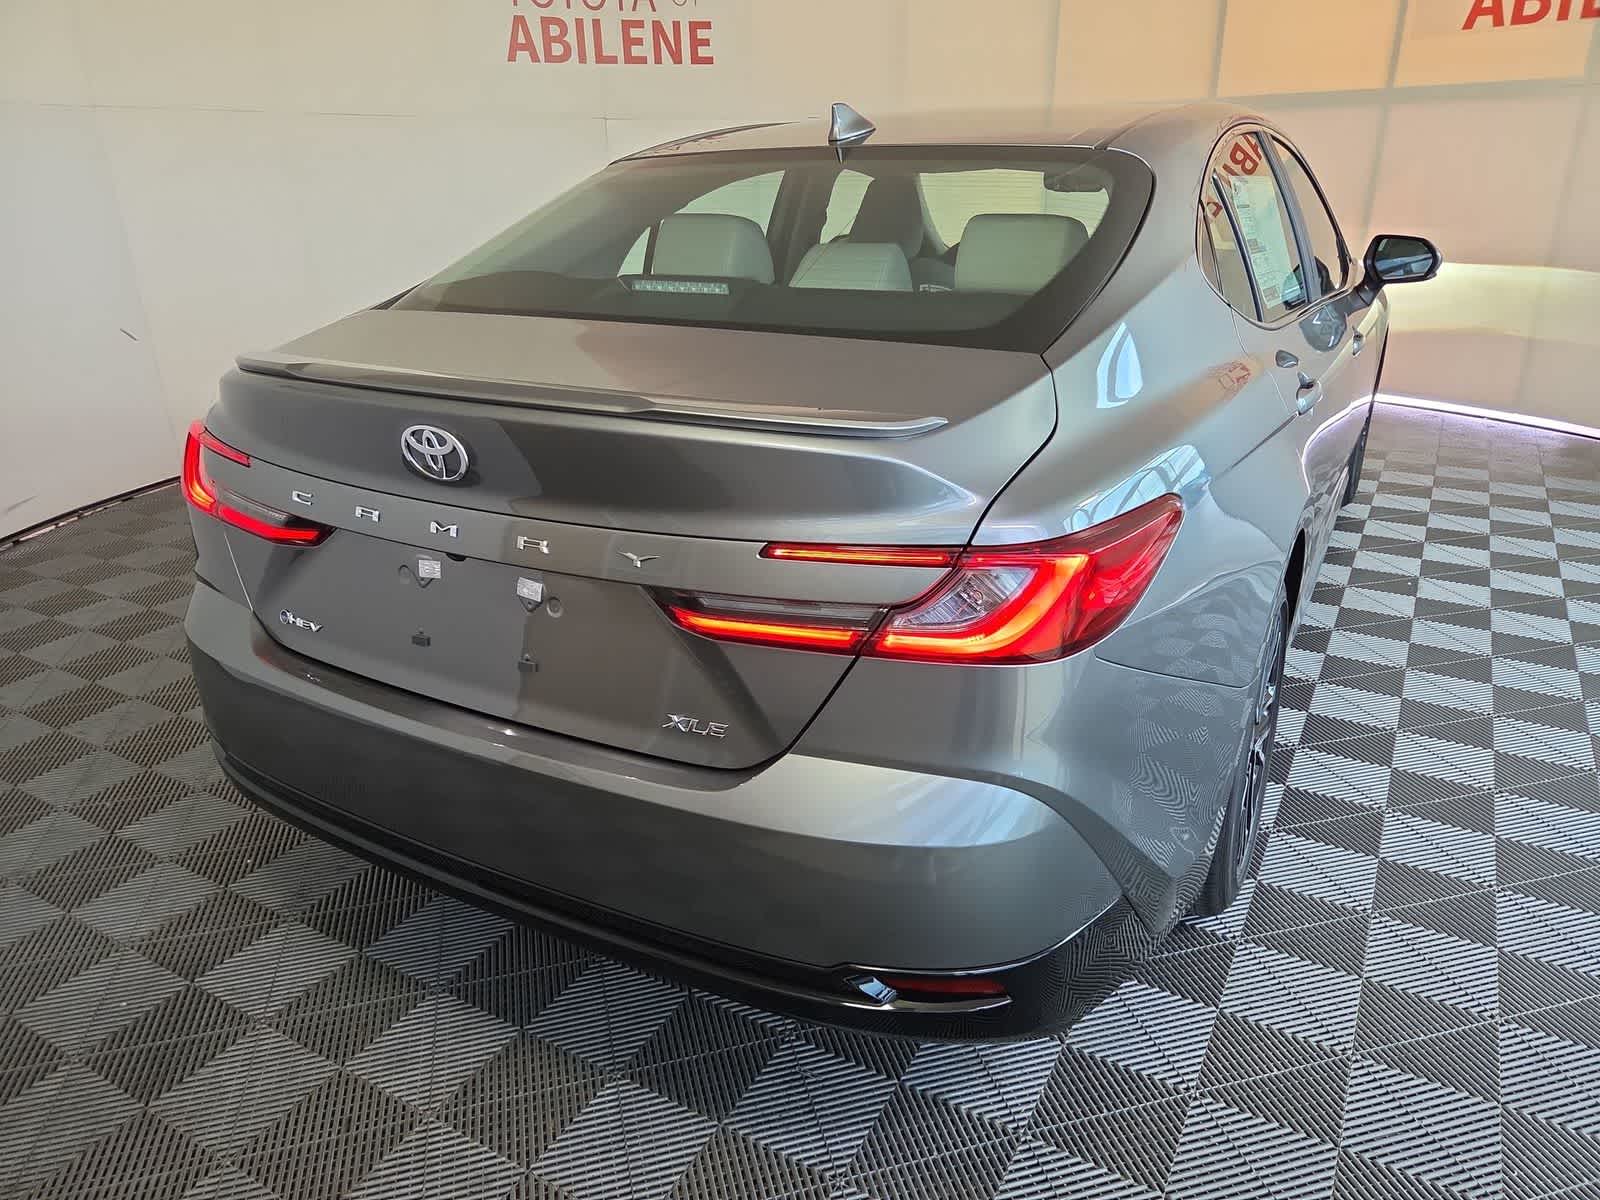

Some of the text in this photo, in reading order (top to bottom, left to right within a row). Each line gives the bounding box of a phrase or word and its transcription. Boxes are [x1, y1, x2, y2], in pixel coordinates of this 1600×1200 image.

[507, 15, 714, 64] ABILENE
[292, 490, 661, 568] CAMRY
[661, 713, 729, 738] XLE
